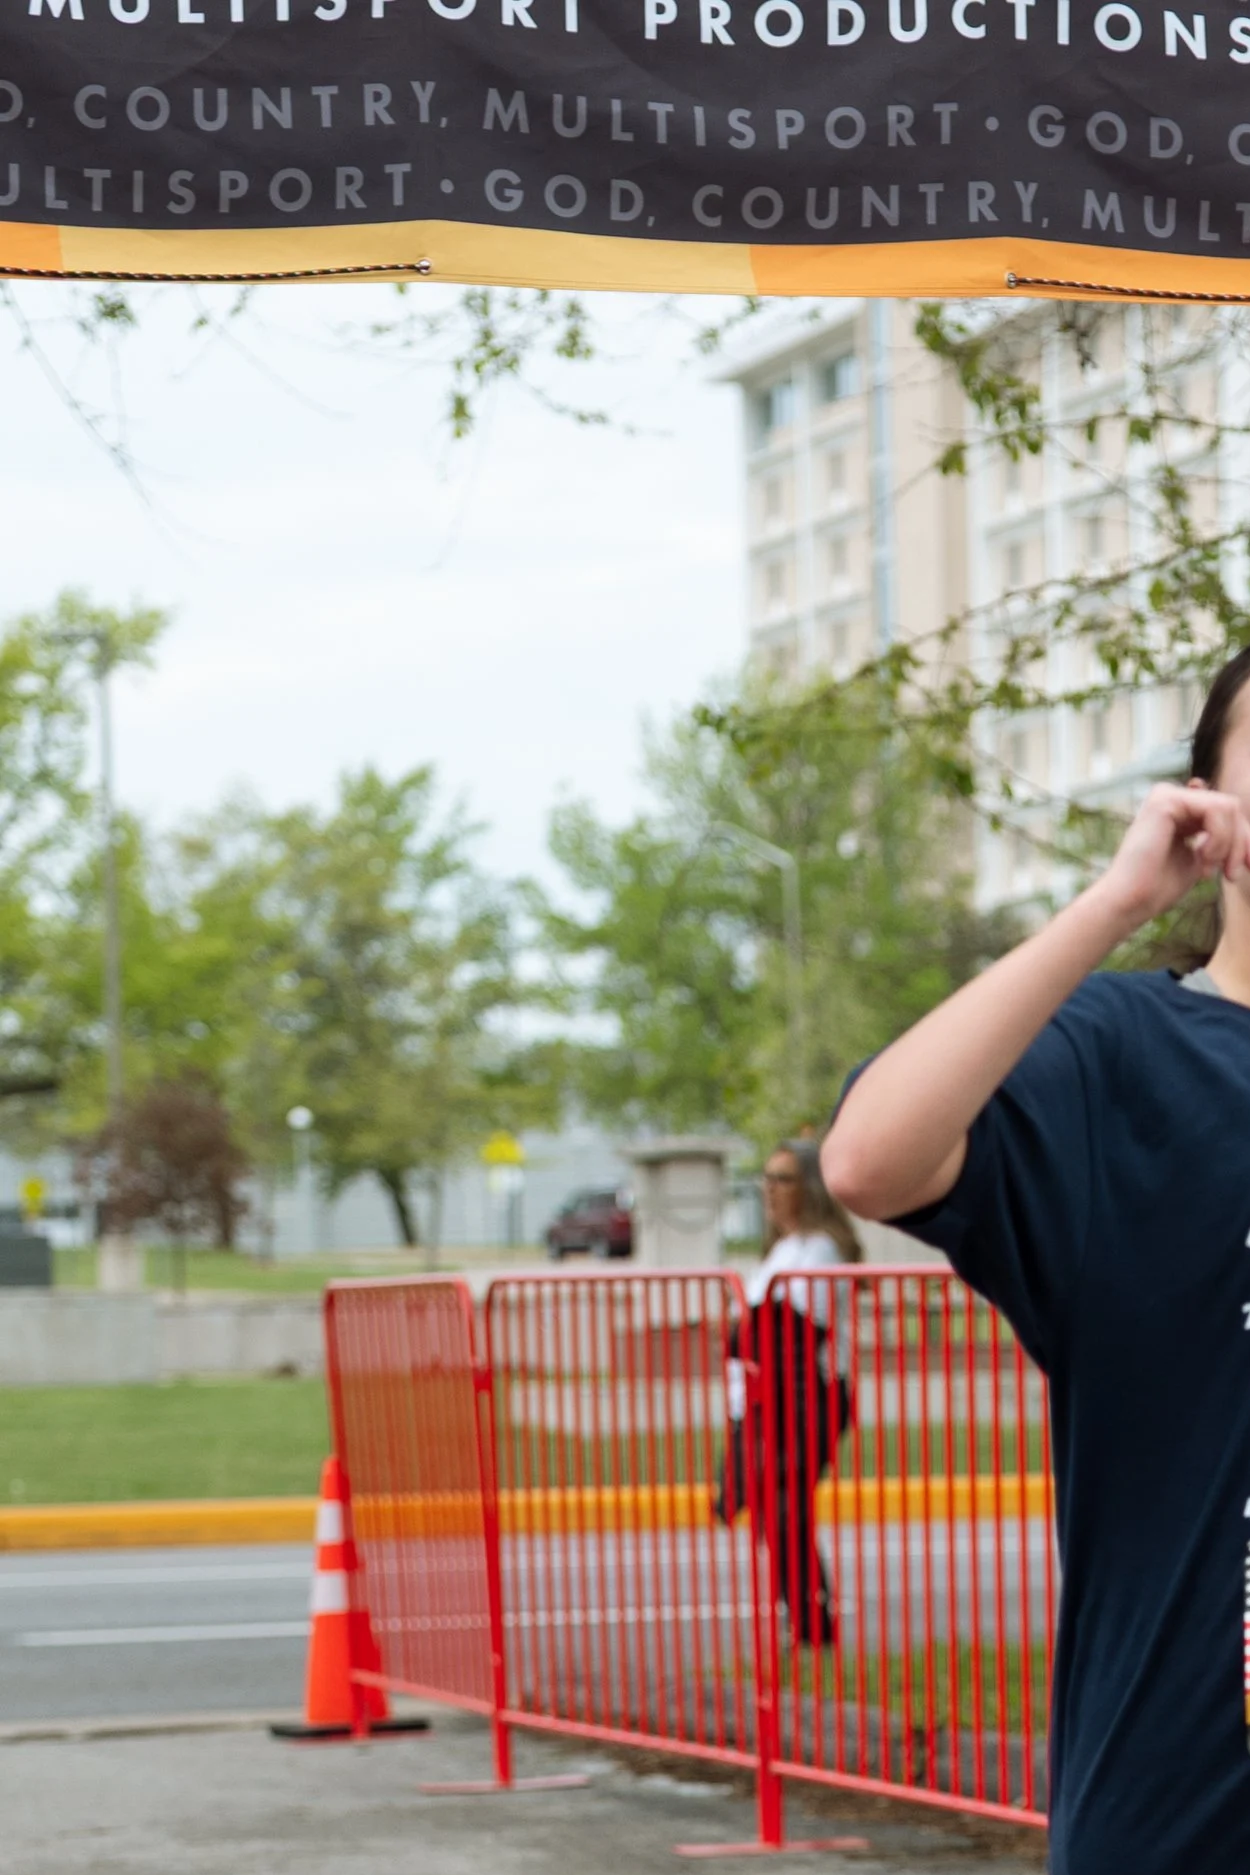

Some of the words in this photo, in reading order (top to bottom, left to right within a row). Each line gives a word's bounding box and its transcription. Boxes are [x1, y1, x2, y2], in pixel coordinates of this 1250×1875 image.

[74, 80, 448, 131] COUNTRY,
[481, 90, 959, 150] MULTISPORT
[1027, 104, 1195, 165] GOD,
[485, 168, 657, 228] GOD,
[691, 180, 1049, 230] COUNTRY,
